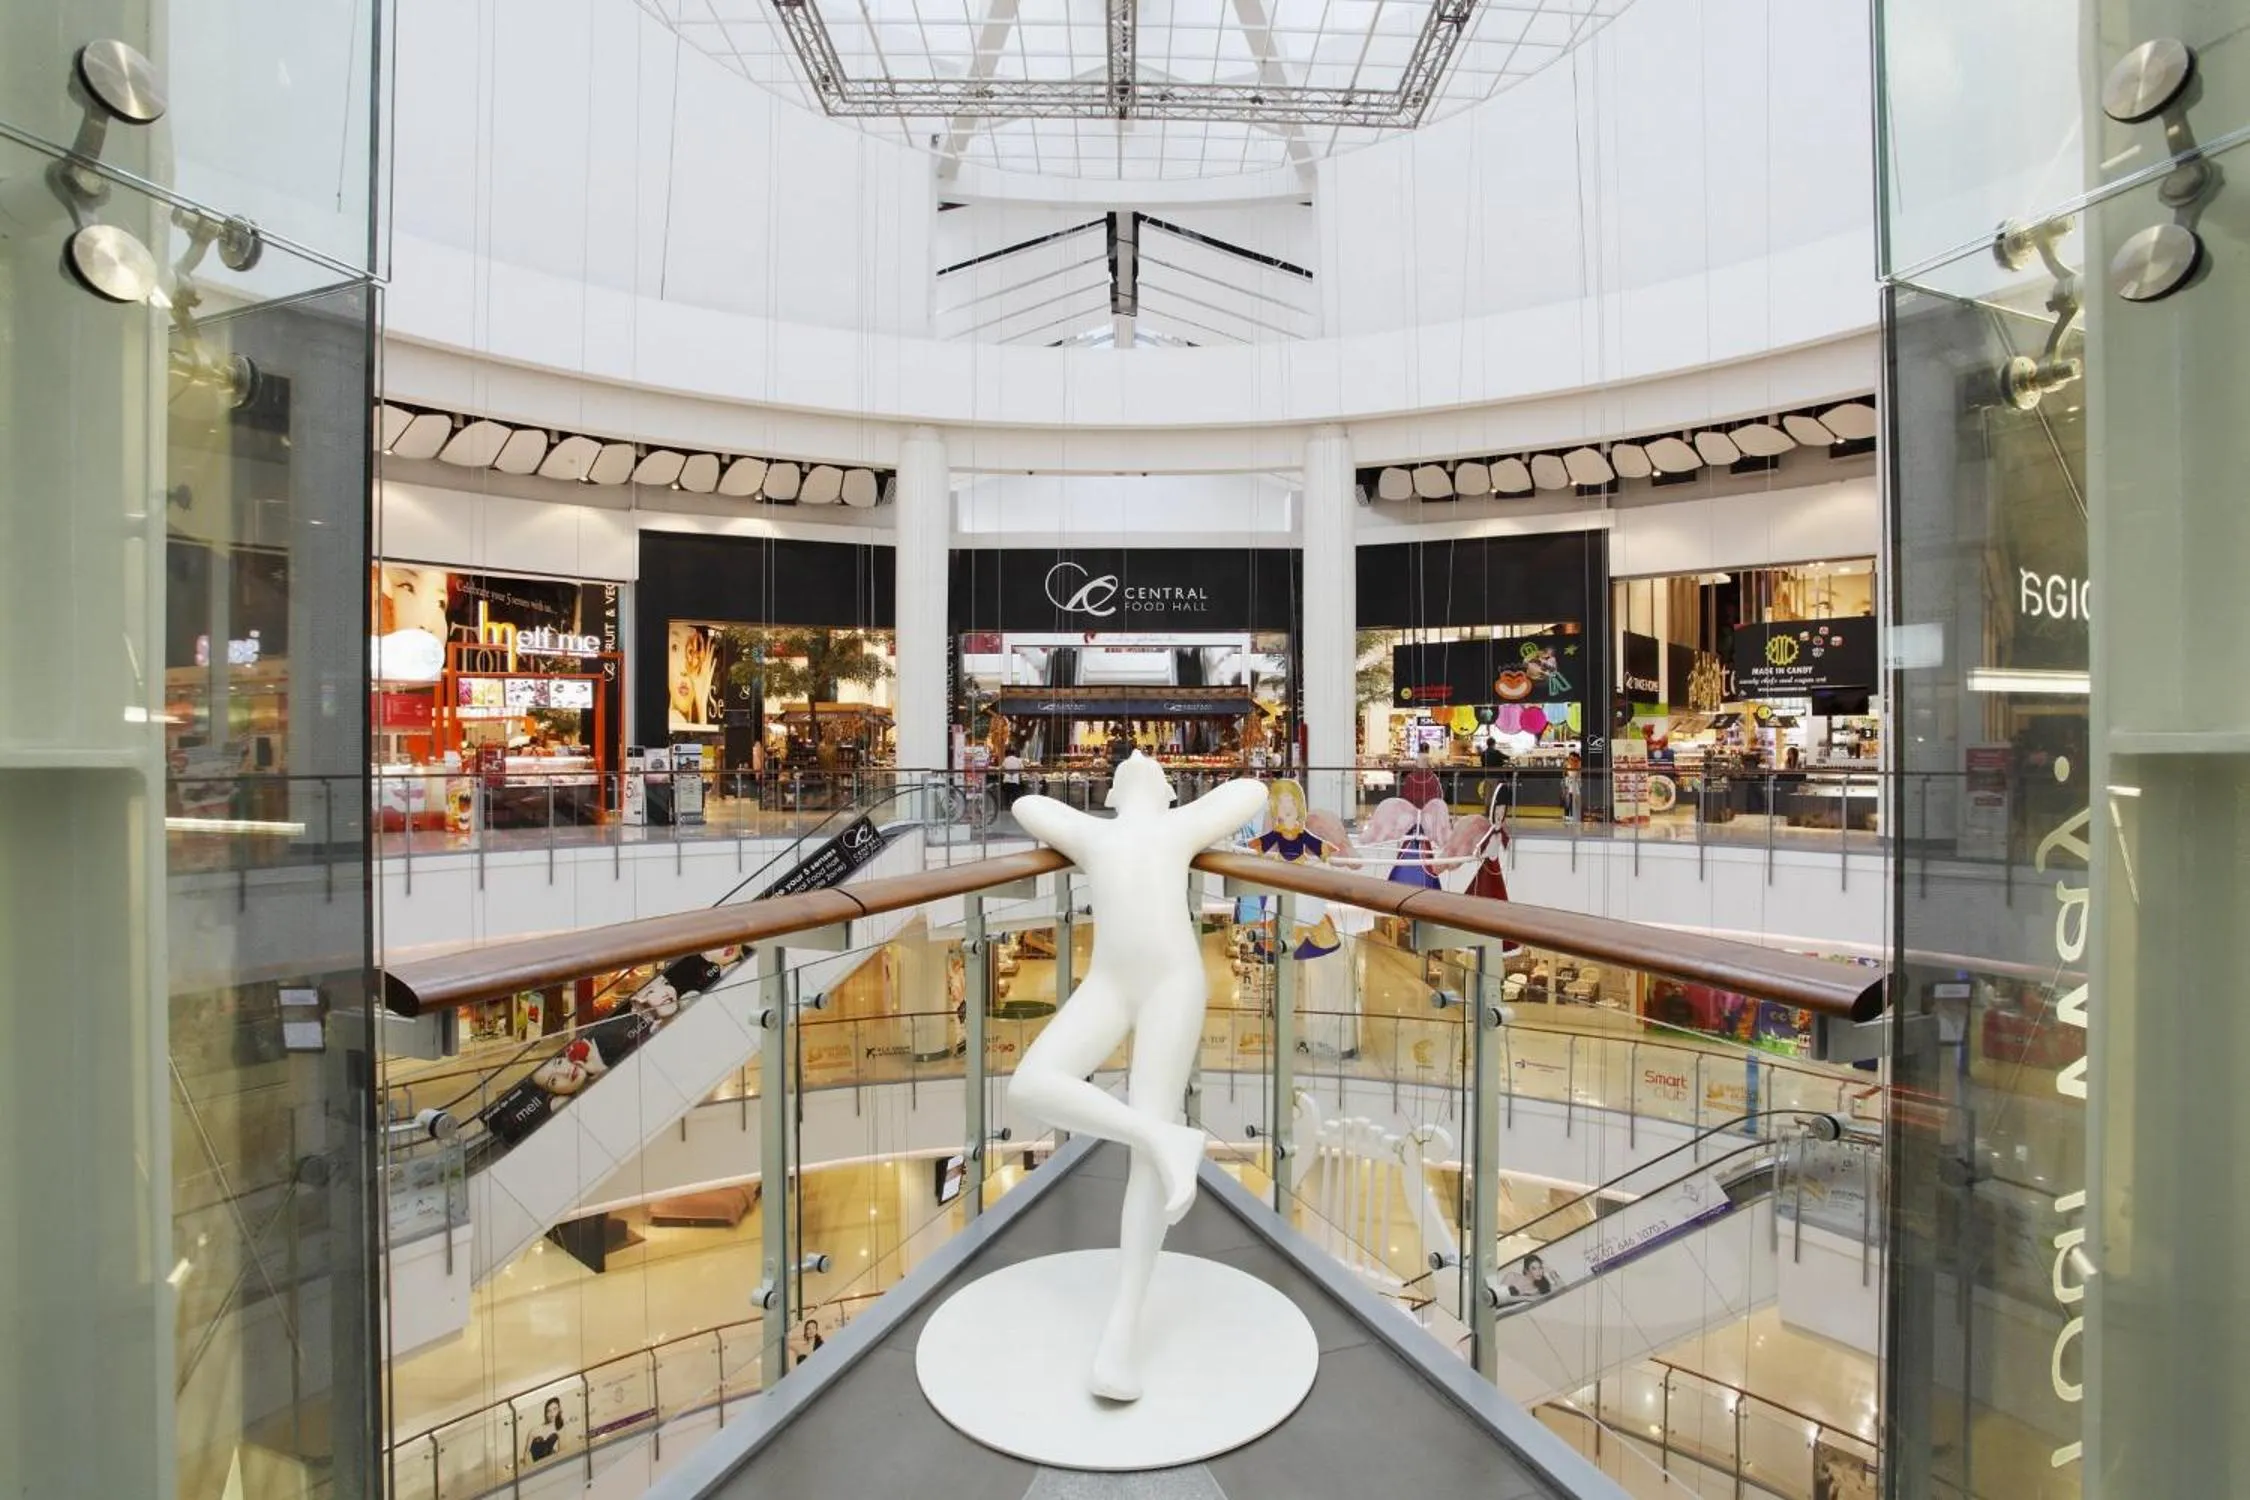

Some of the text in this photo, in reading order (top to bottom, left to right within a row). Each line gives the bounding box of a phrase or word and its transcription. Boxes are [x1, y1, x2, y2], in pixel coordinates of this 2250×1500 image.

[1124, 587, 1208, 599] CENTRAL
[1124, 602, 1208, 611] FOOD HALL
[479, 601, 601, 672] melt me
[1751, 665, 1813, 675] MADE IN CANDY
[1645, 1070, 1688, 1089] Smart
